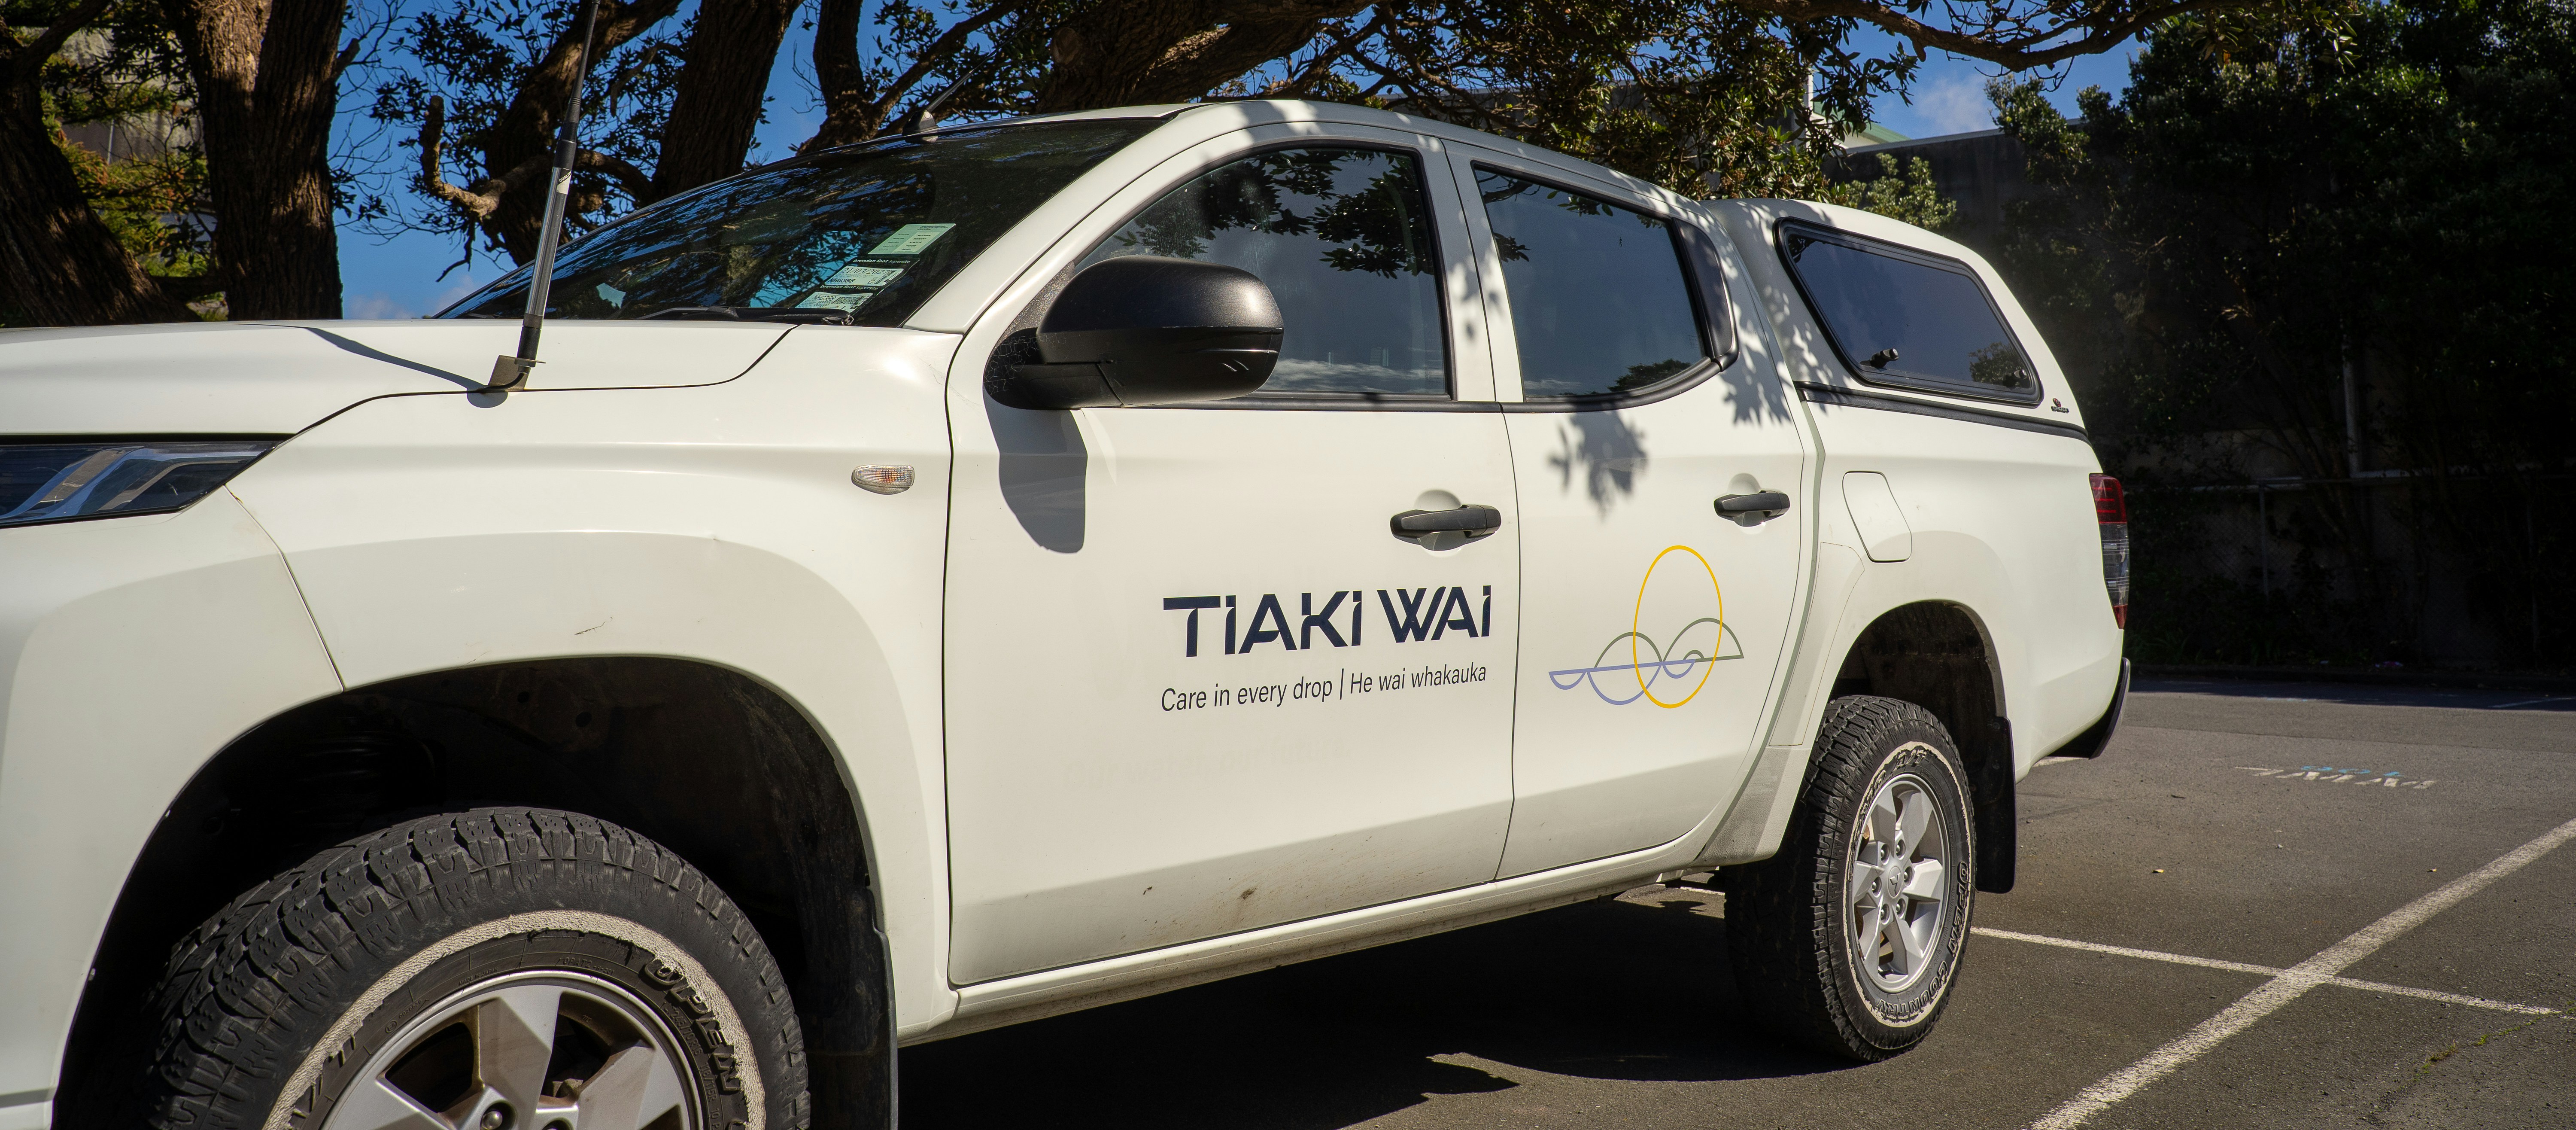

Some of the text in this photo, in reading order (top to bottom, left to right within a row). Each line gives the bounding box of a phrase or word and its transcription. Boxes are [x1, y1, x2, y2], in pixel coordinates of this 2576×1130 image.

[1161, 688, 1206, 711] Care
[1214, 683, 1230, 707] in
[1237, 684, 1287, 707] every
[1293, 676, 1332, 702] drop
[1350, 672, 1373, 694] He
[1379, 667, 1405, 691] wai
[1411, 661, 1486, 688] whakauka
[1947, 861, 1969, 957] OPEN
[459, 975, 474, 986] MADE
[481, 967, 498, 977] JAPAN
[1875, 960, 1948, 1019] COUNTRY
[710, 1108, 720, 1120] 10
